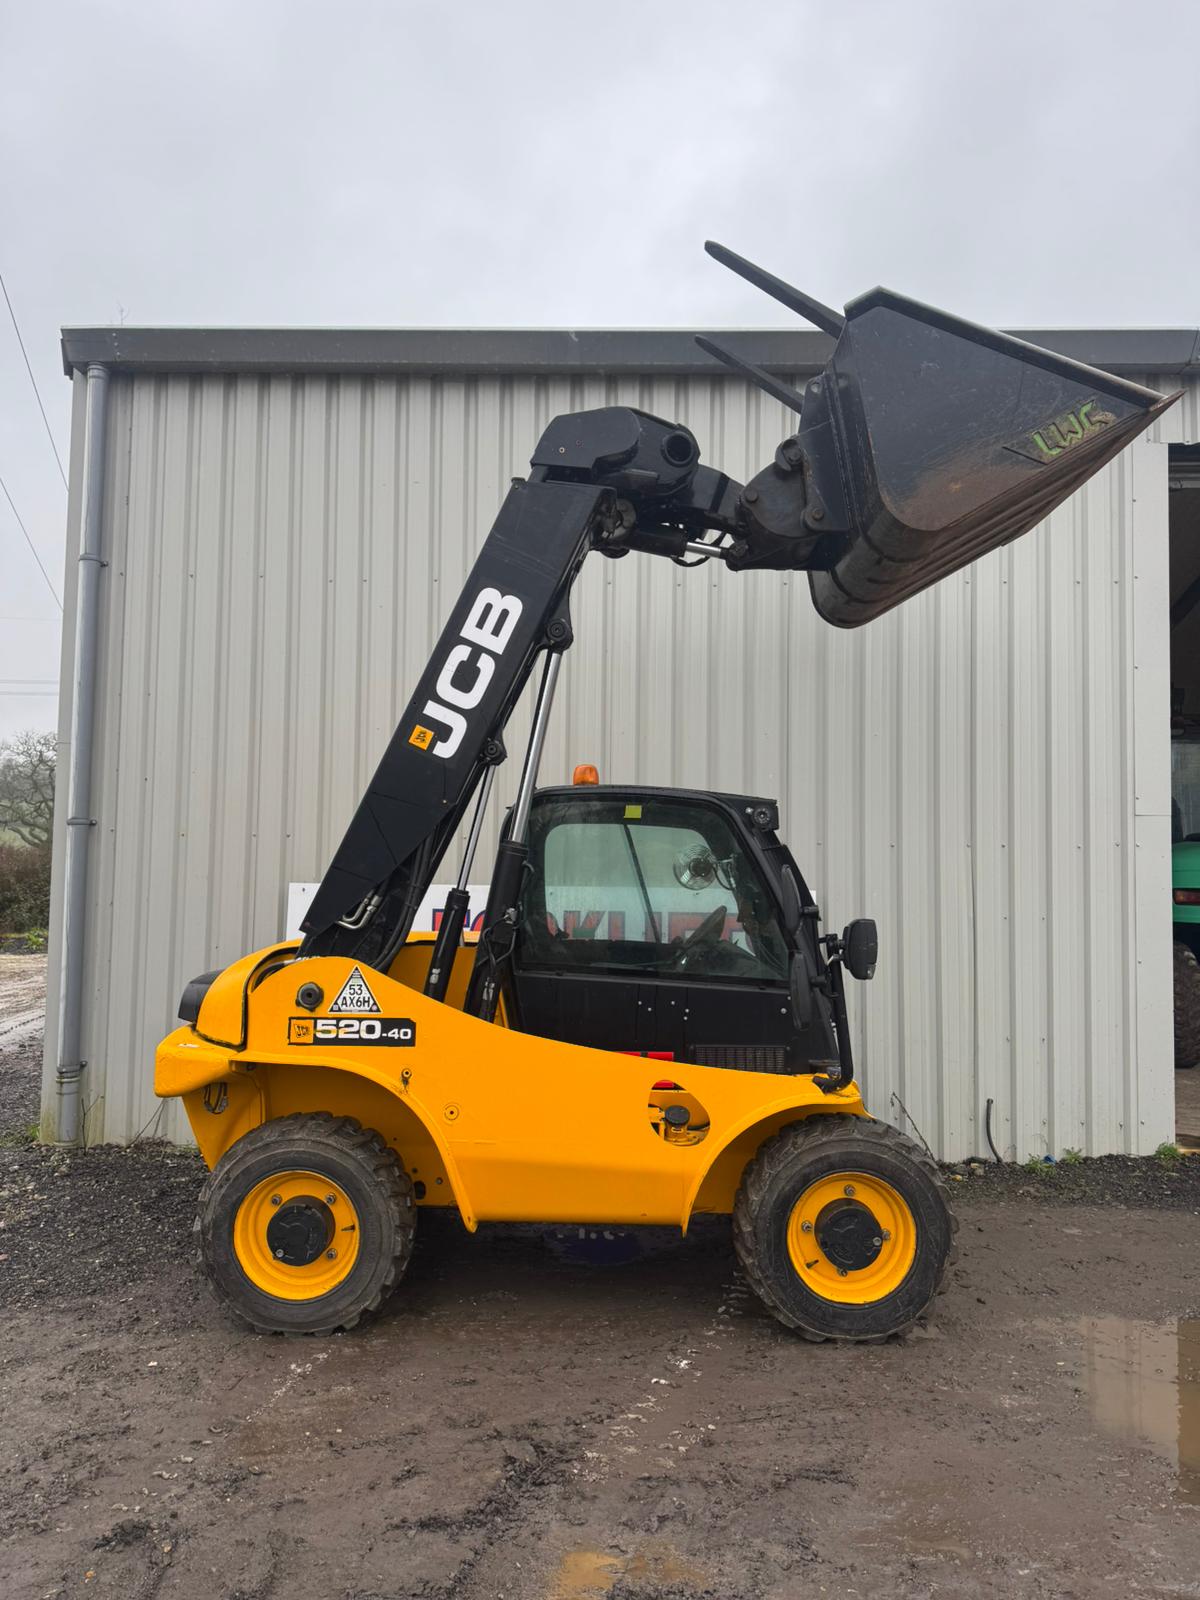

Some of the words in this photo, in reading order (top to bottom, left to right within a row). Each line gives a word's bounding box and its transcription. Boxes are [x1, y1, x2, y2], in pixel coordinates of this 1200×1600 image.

[422, 587, 523, 759] JCB
[348, 984, 363, 996] 53
[341, 996, 370, 1008] AX6H
[315, 1019, 412, 1040] 520-40
